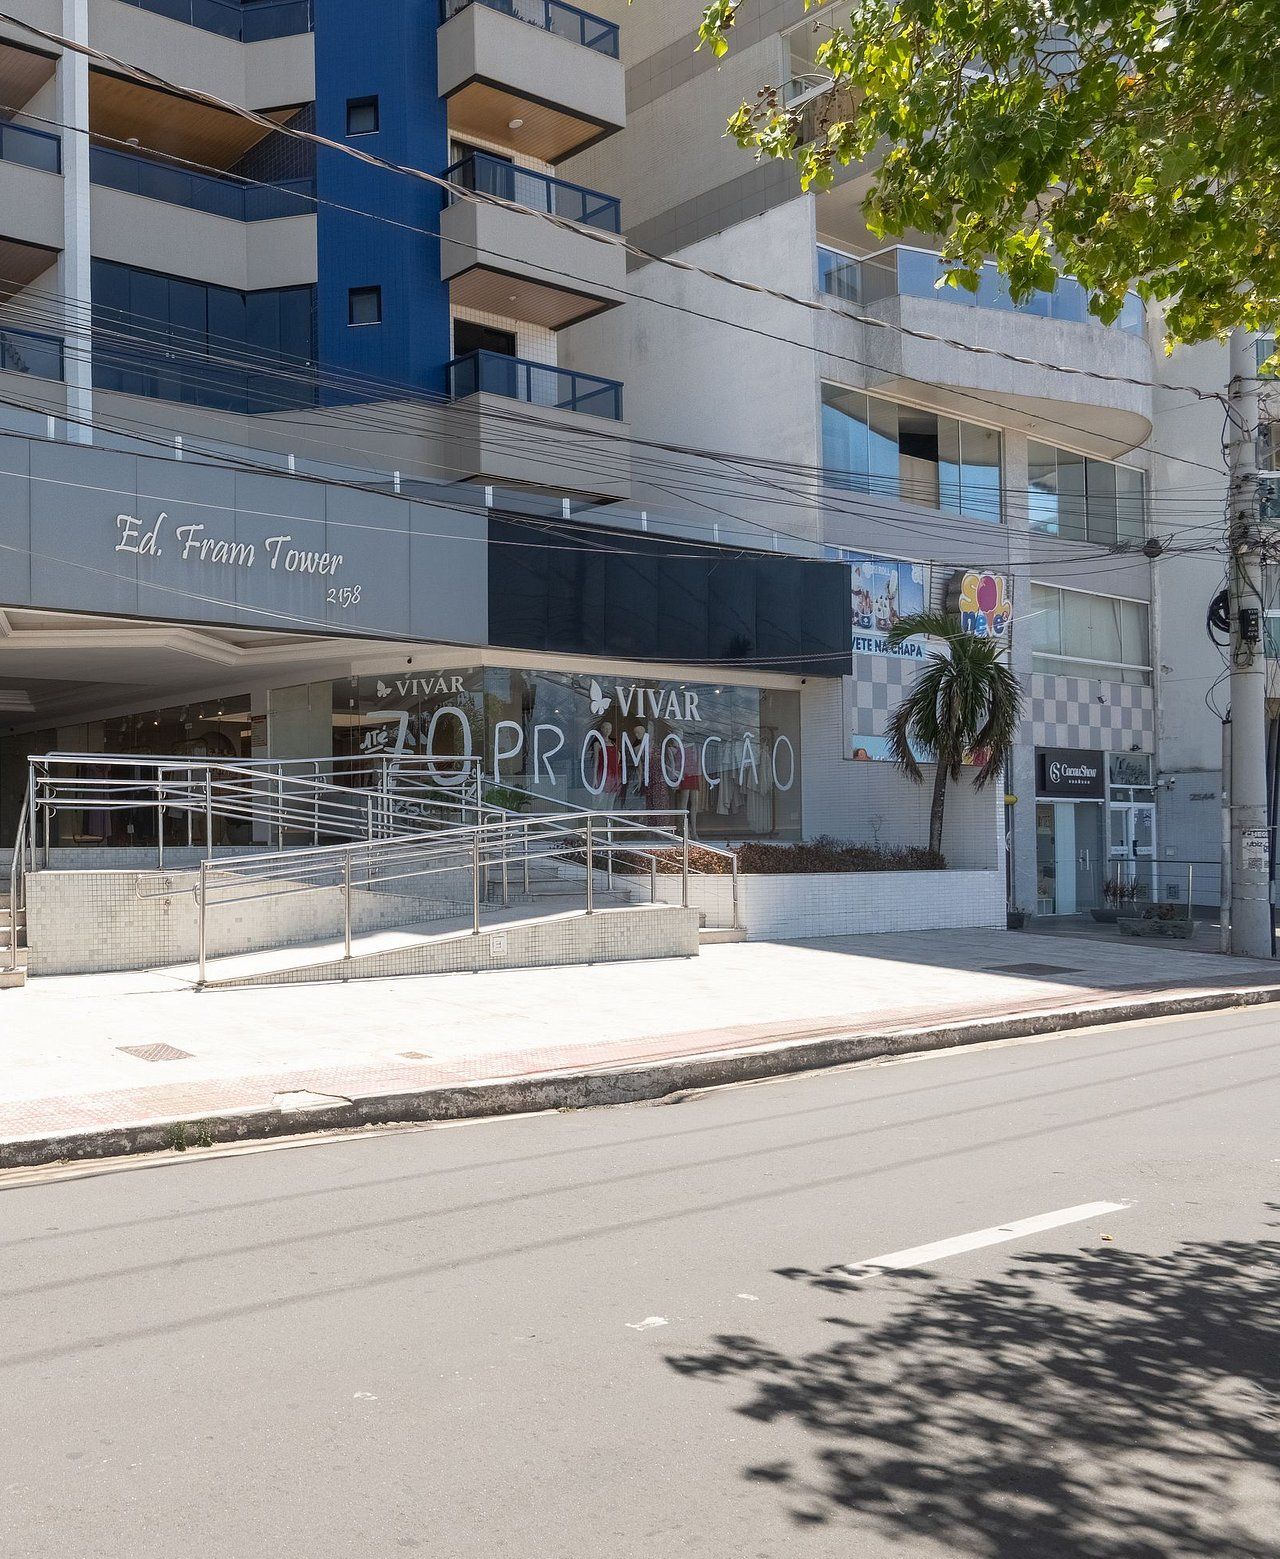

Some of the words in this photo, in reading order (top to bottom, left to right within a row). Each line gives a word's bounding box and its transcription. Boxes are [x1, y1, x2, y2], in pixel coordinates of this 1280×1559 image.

[115, 512, 168, 556] Ed.
[176, 524, 256, 567] Fram
[264, 535, 344, 575] Tower
[326, 584, 362, 608] 2158
[395, 676, 465, 696] VIVAR
[615, 686, 703, 722] VIVAR
[494, 720, 795, 796] PROMOÇÃO
